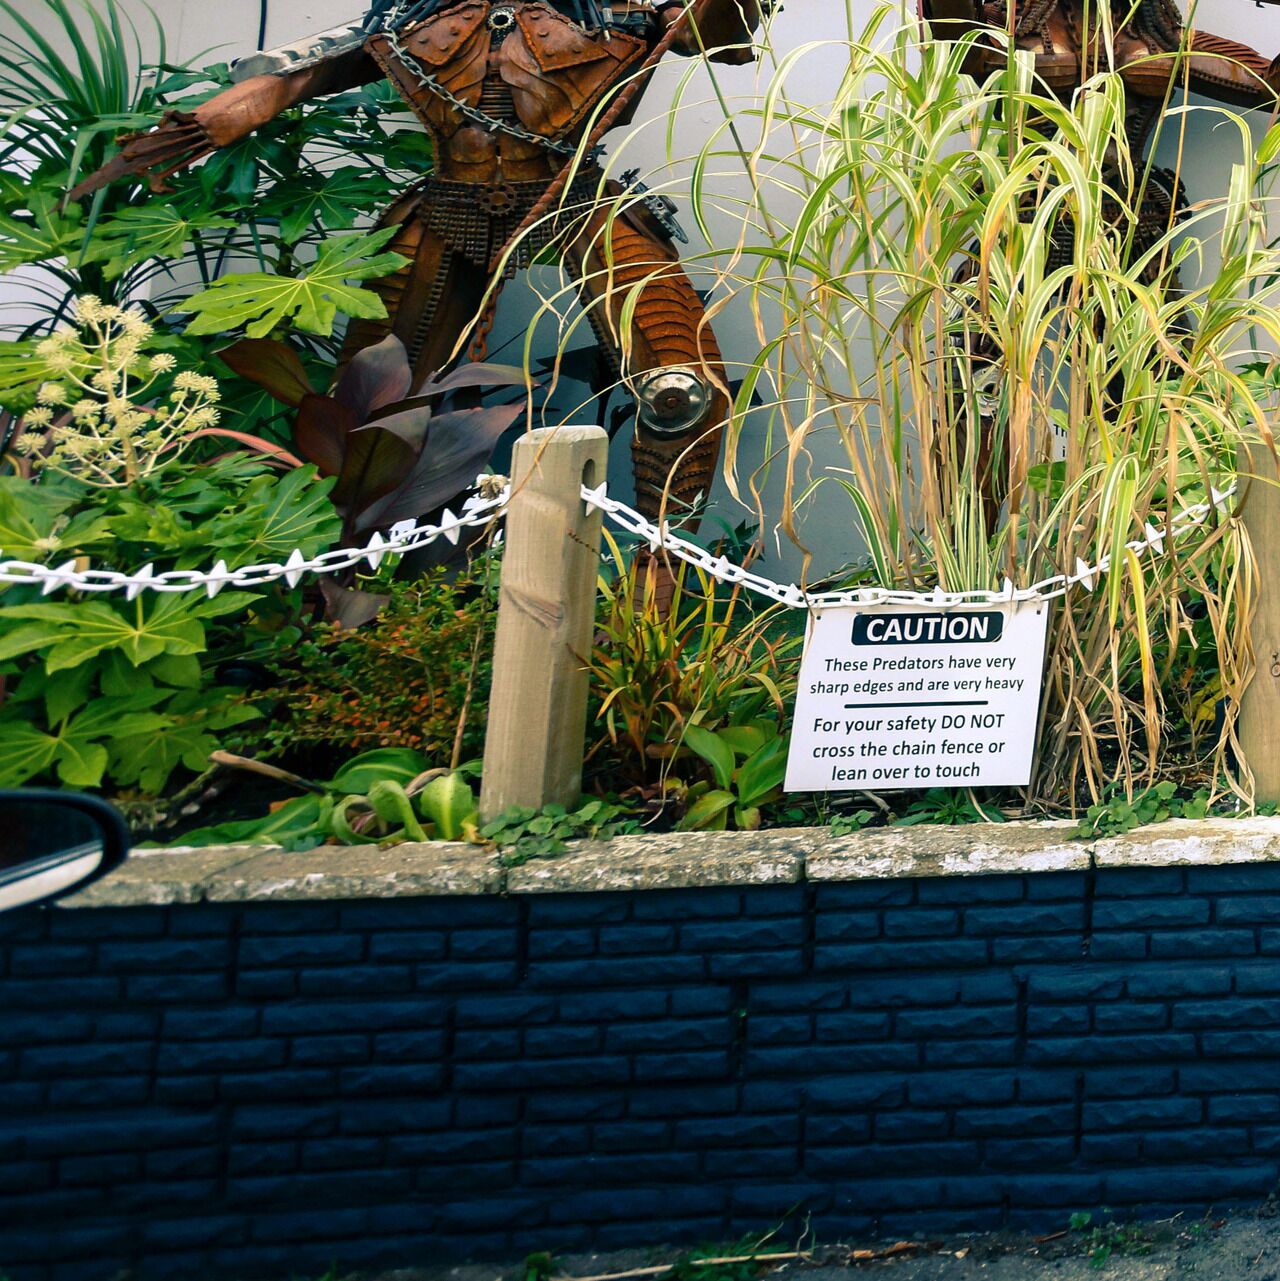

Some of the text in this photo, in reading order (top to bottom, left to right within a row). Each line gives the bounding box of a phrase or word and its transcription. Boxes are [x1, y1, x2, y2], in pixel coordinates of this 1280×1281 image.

[866, 616, 989, 642] CAUTION
[824, 654, 1017, 672] These Predators have very
[810, 676, 1024, 696] sharp edges and are very heavy
[813, 713, 1005, 735] For your safety DO NOT
[812, 739, 1006, 758] cross the chain fence or
[831, 761, 980, 781] lean over to touch
